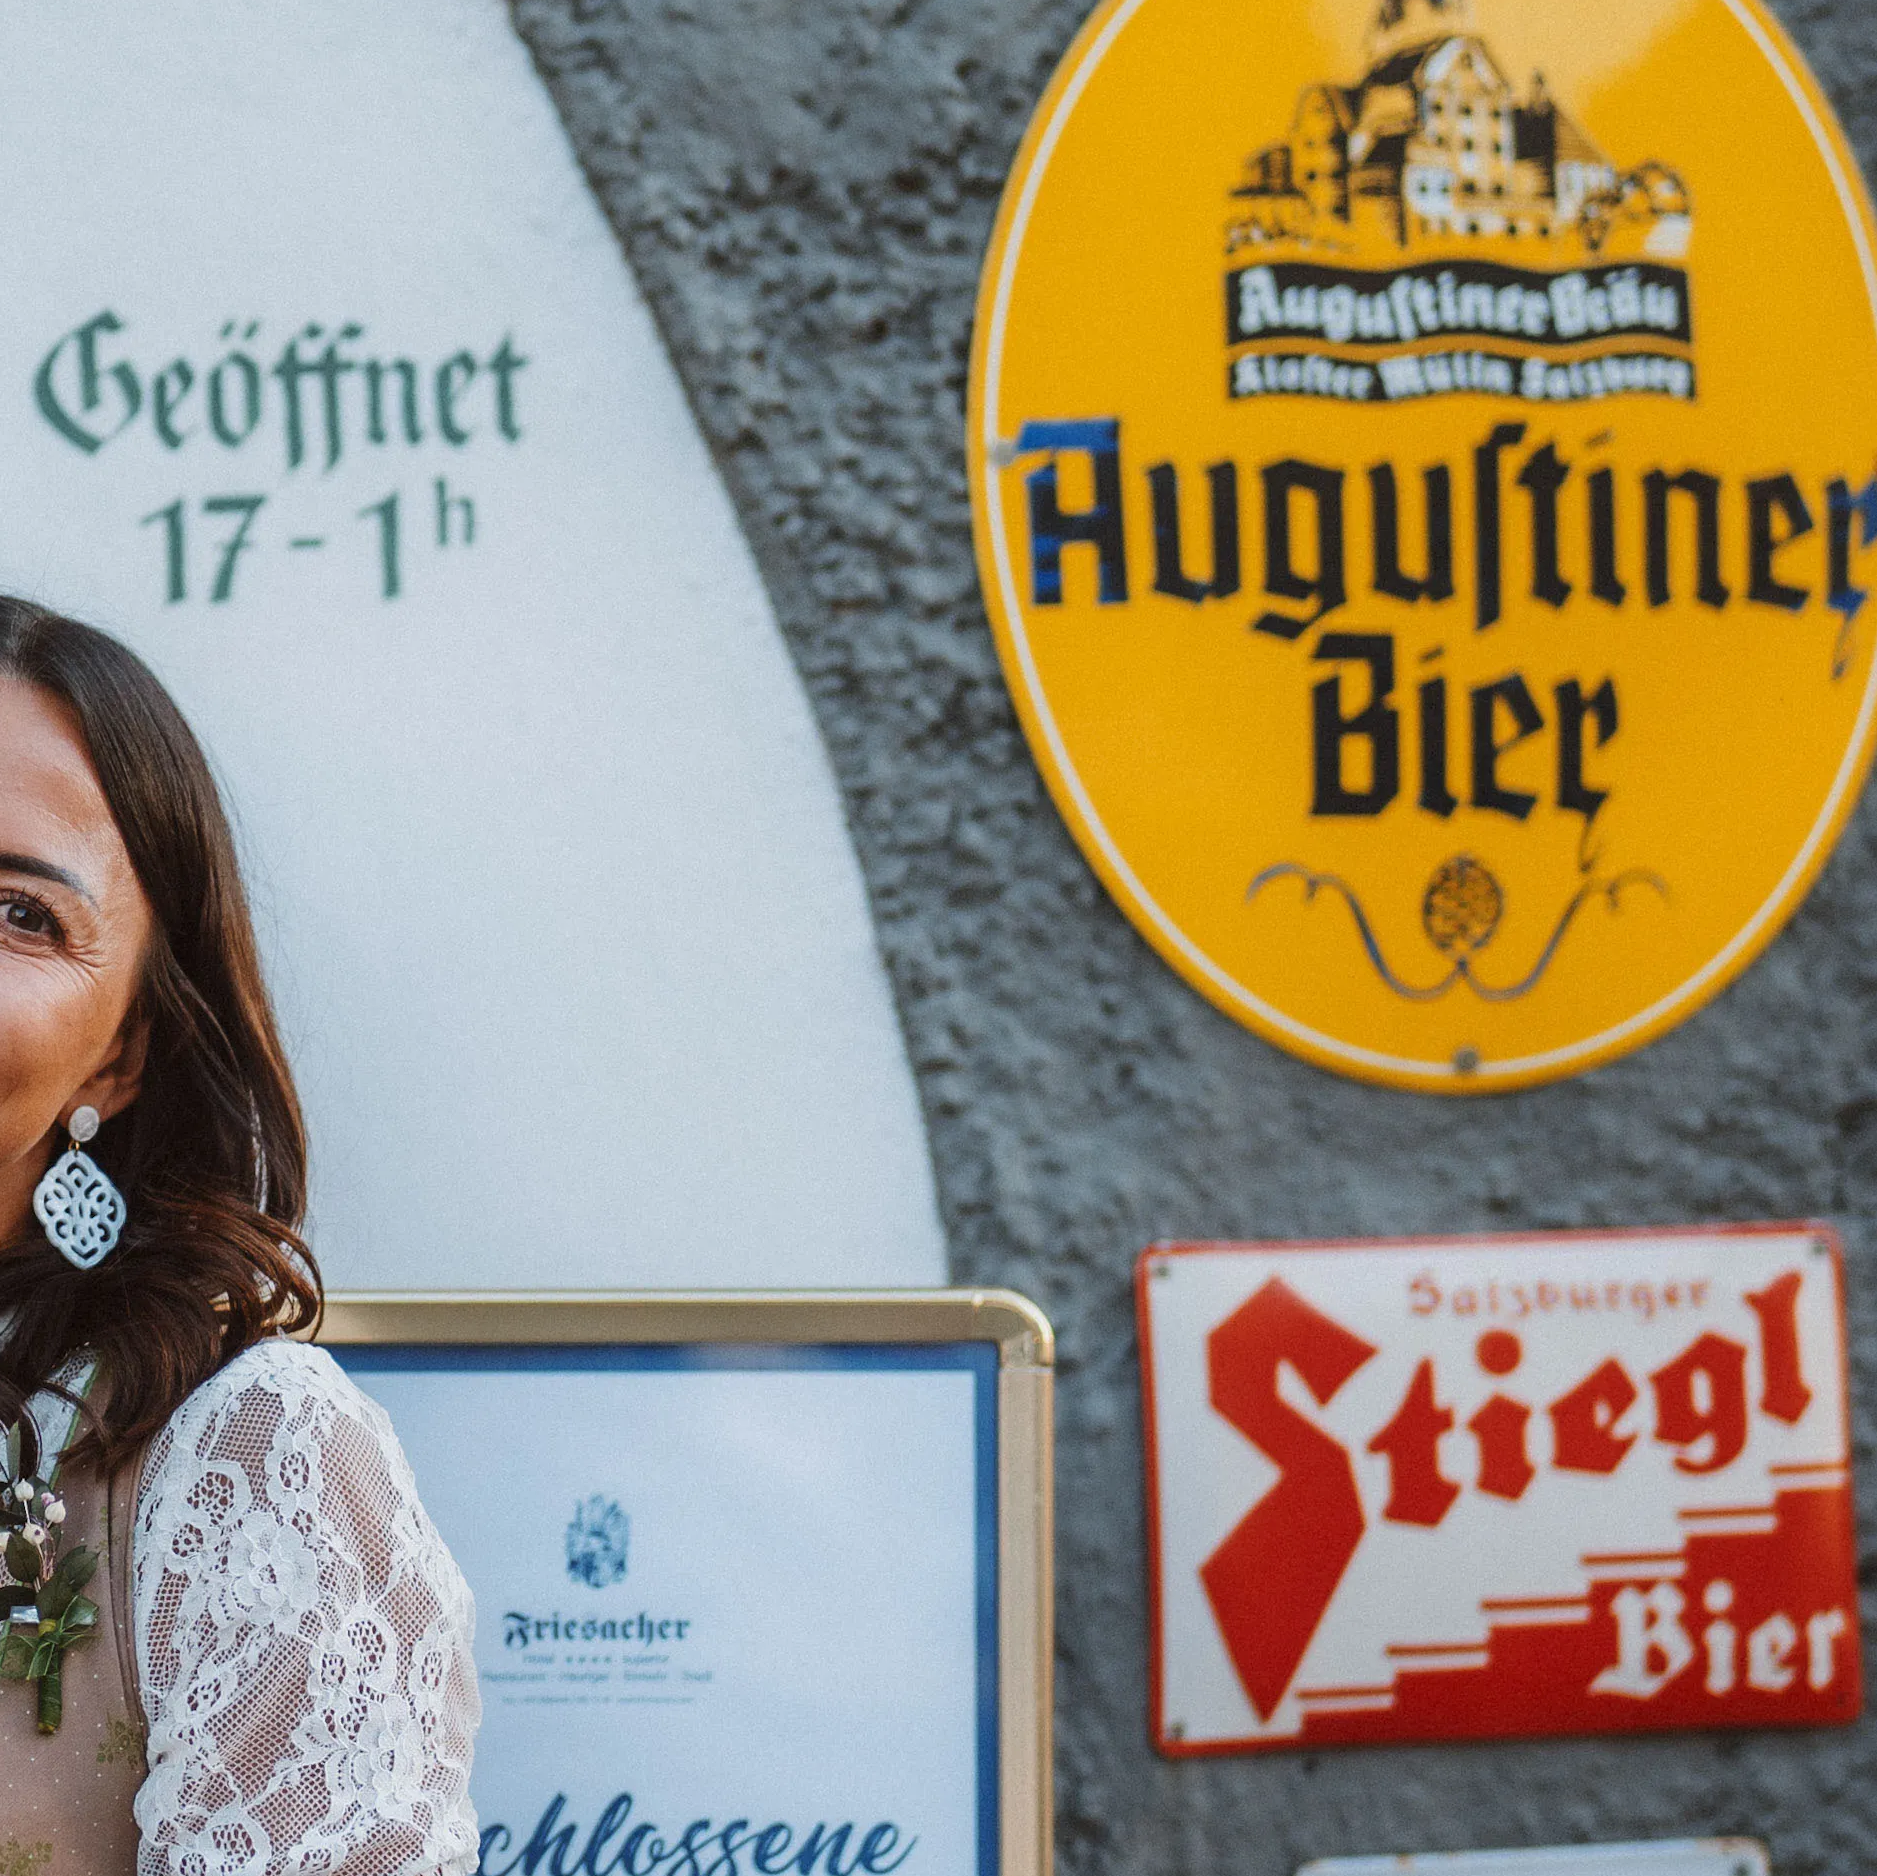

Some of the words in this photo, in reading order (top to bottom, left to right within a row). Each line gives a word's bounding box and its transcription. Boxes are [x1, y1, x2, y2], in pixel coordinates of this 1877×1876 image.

[33, 309, 531, 475] Geöffnet
[1306, 632, 1621, 872] Bier
[1407, 1270, 1713, 1322] Salzburger
[1198, 1270, 1813, 1725] Stiegl
[503, 1611, 691, 1648] Friesacher
[1588, 1579, 1846, 1700] Bier
